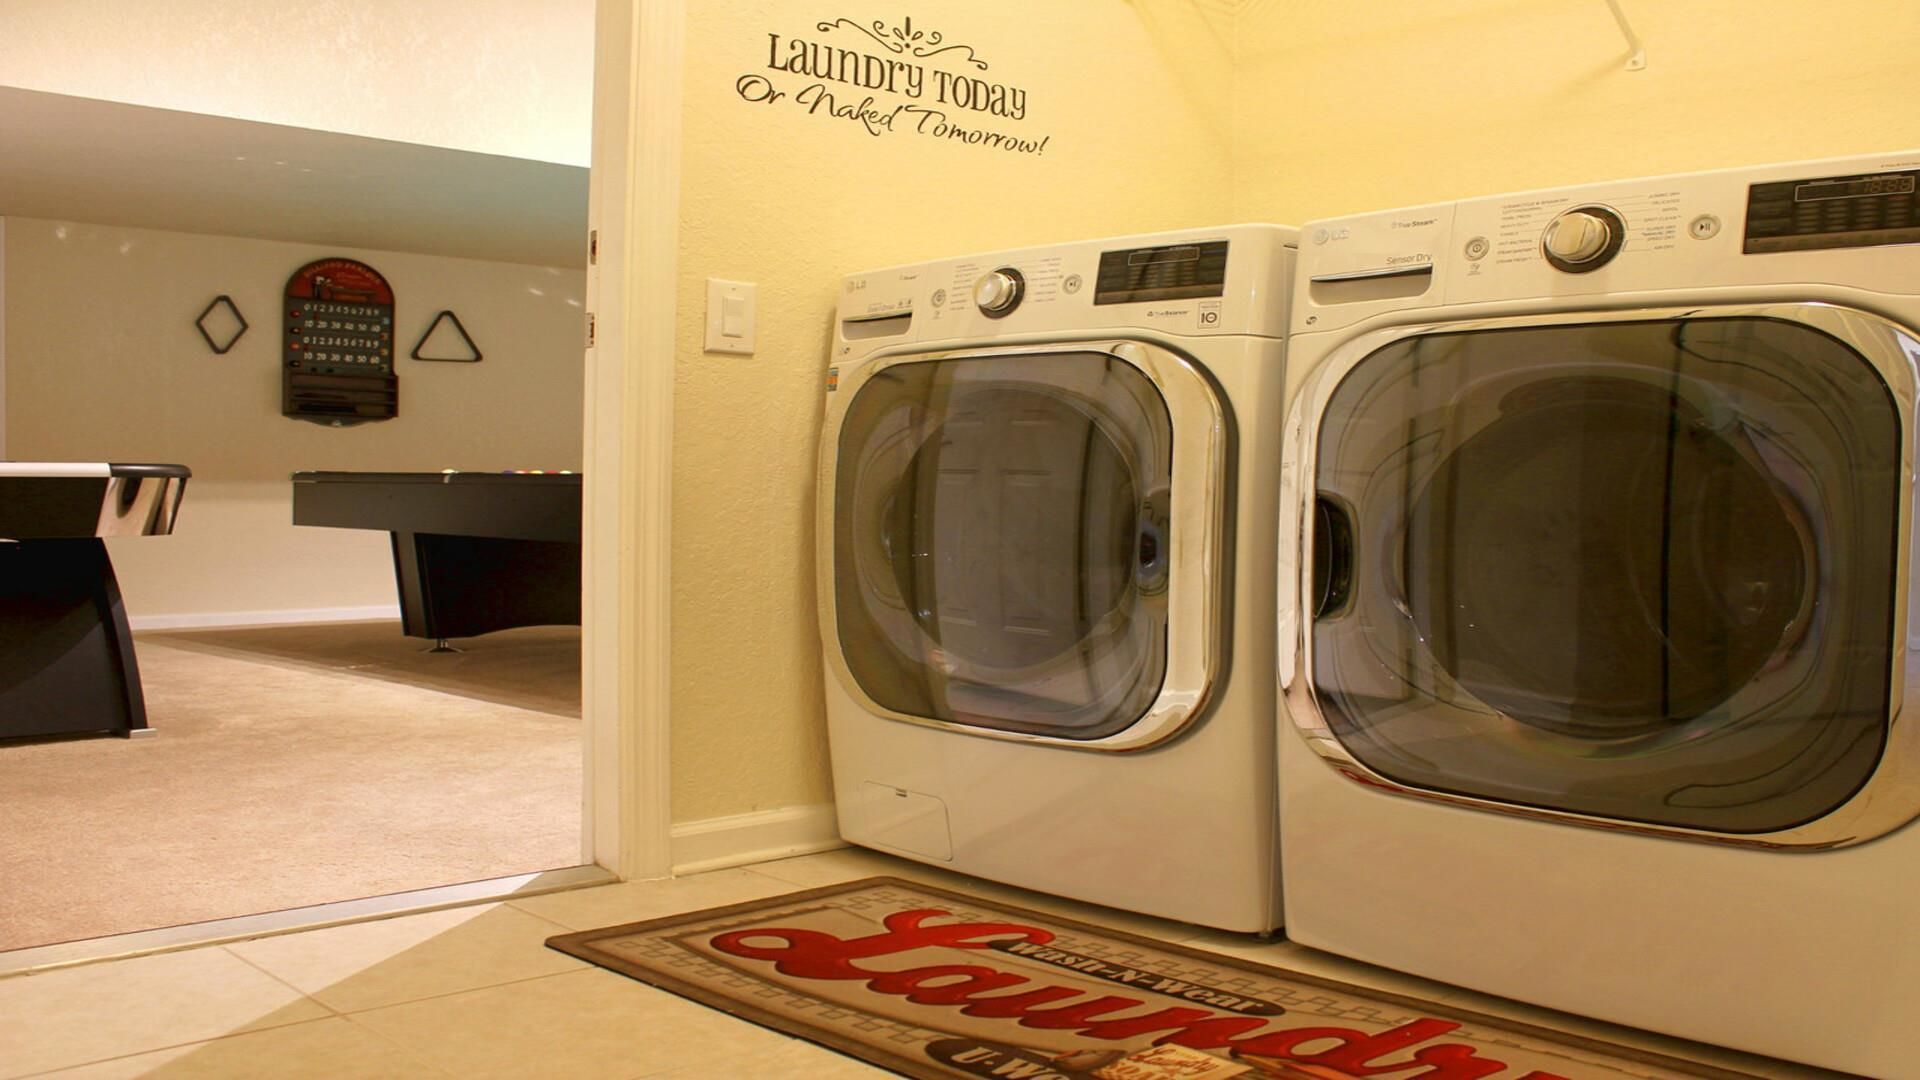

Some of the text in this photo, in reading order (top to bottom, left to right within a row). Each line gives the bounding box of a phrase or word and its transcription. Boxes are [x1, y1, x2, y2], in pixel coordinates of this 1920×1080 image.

[736, 74, 1050, 156] Or Naked Tomorrow!
[1386, 253, 1432, 265] Sensor Dry
[709, 908, 1576, 1080] Laundr
[1007, 941, 1265, 1013] Wash-N-Wear
